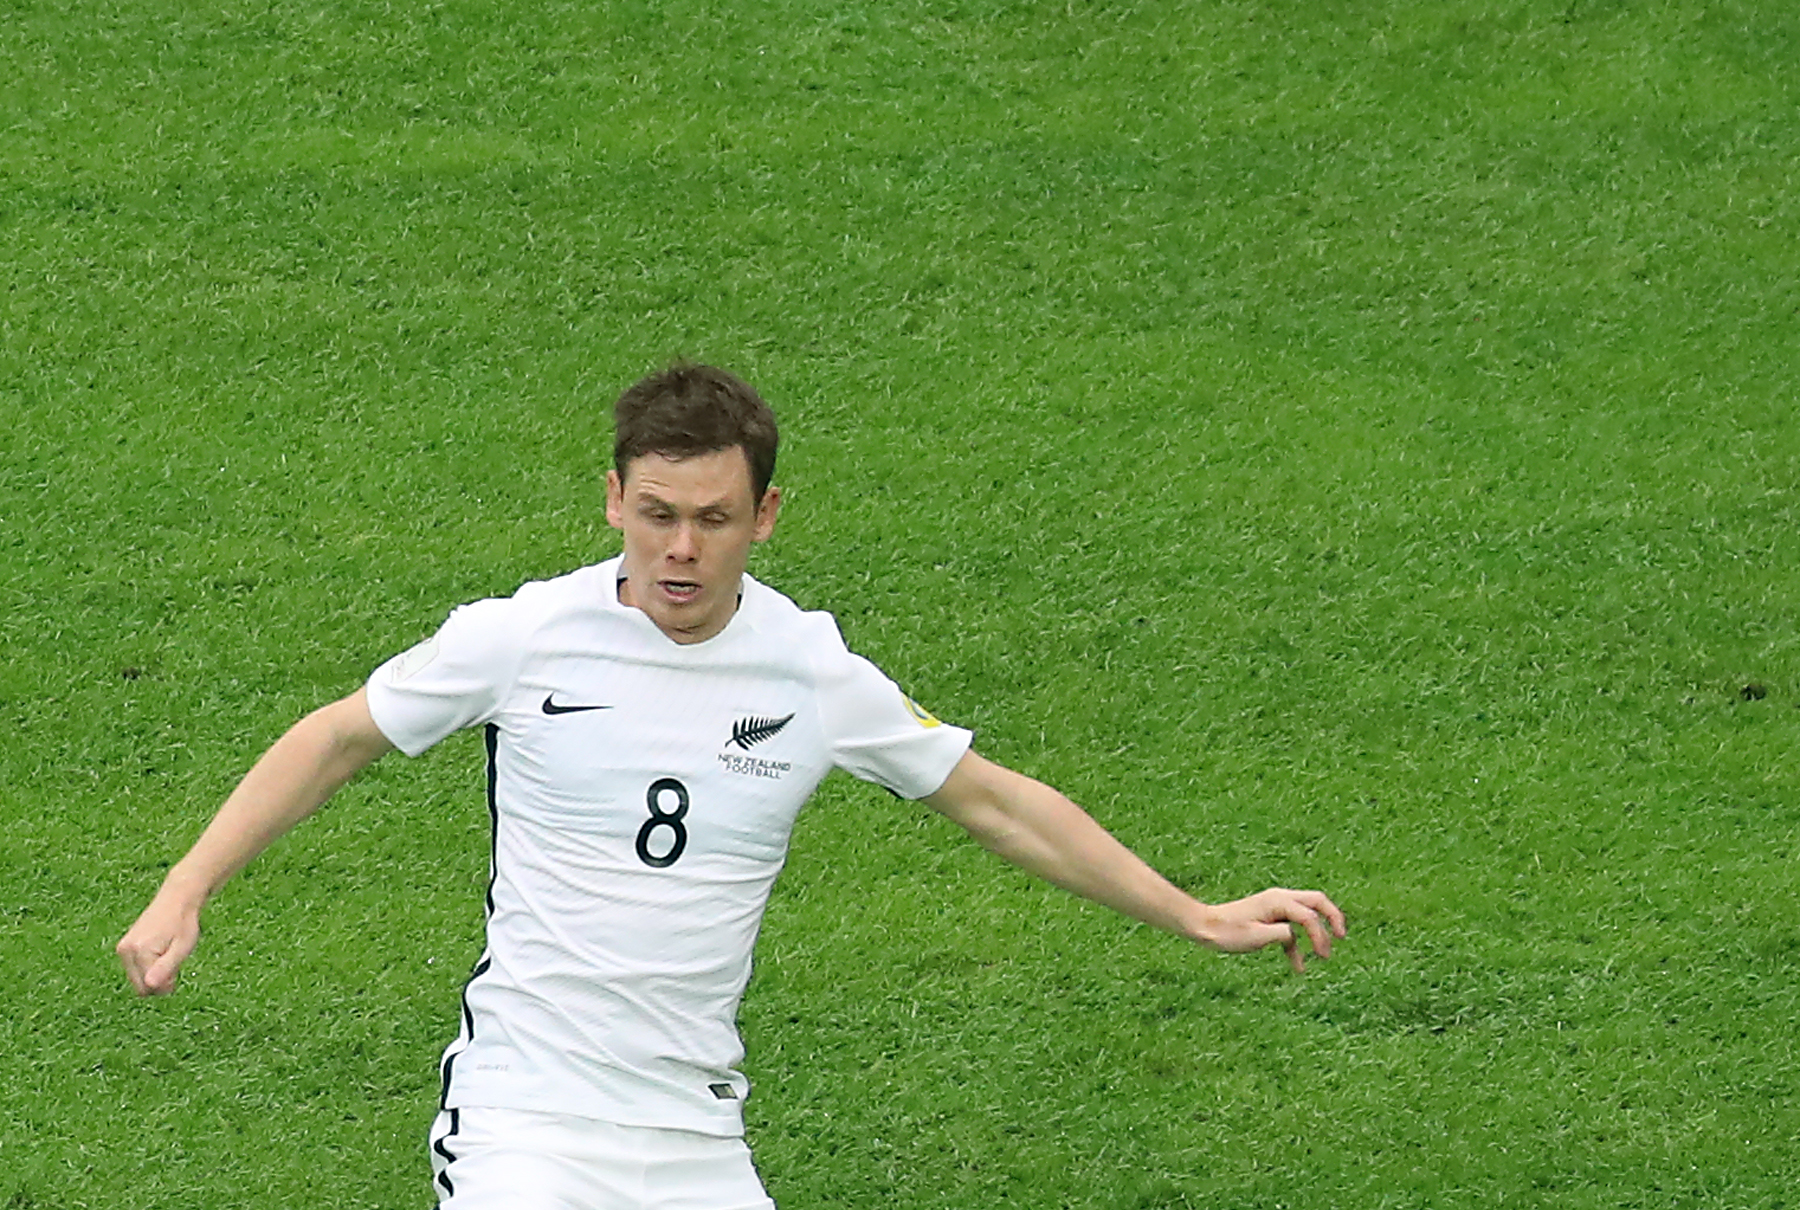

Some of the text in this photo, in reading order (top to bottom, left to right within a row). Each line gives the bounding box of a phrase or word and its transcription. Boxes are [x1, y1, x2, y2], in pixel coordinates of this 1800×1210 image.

[718, 753, 791, 771] NEW ZEALAND
[726, 761, 782, 779] FOOTBALL
[635, 777, 689, 868] 8
